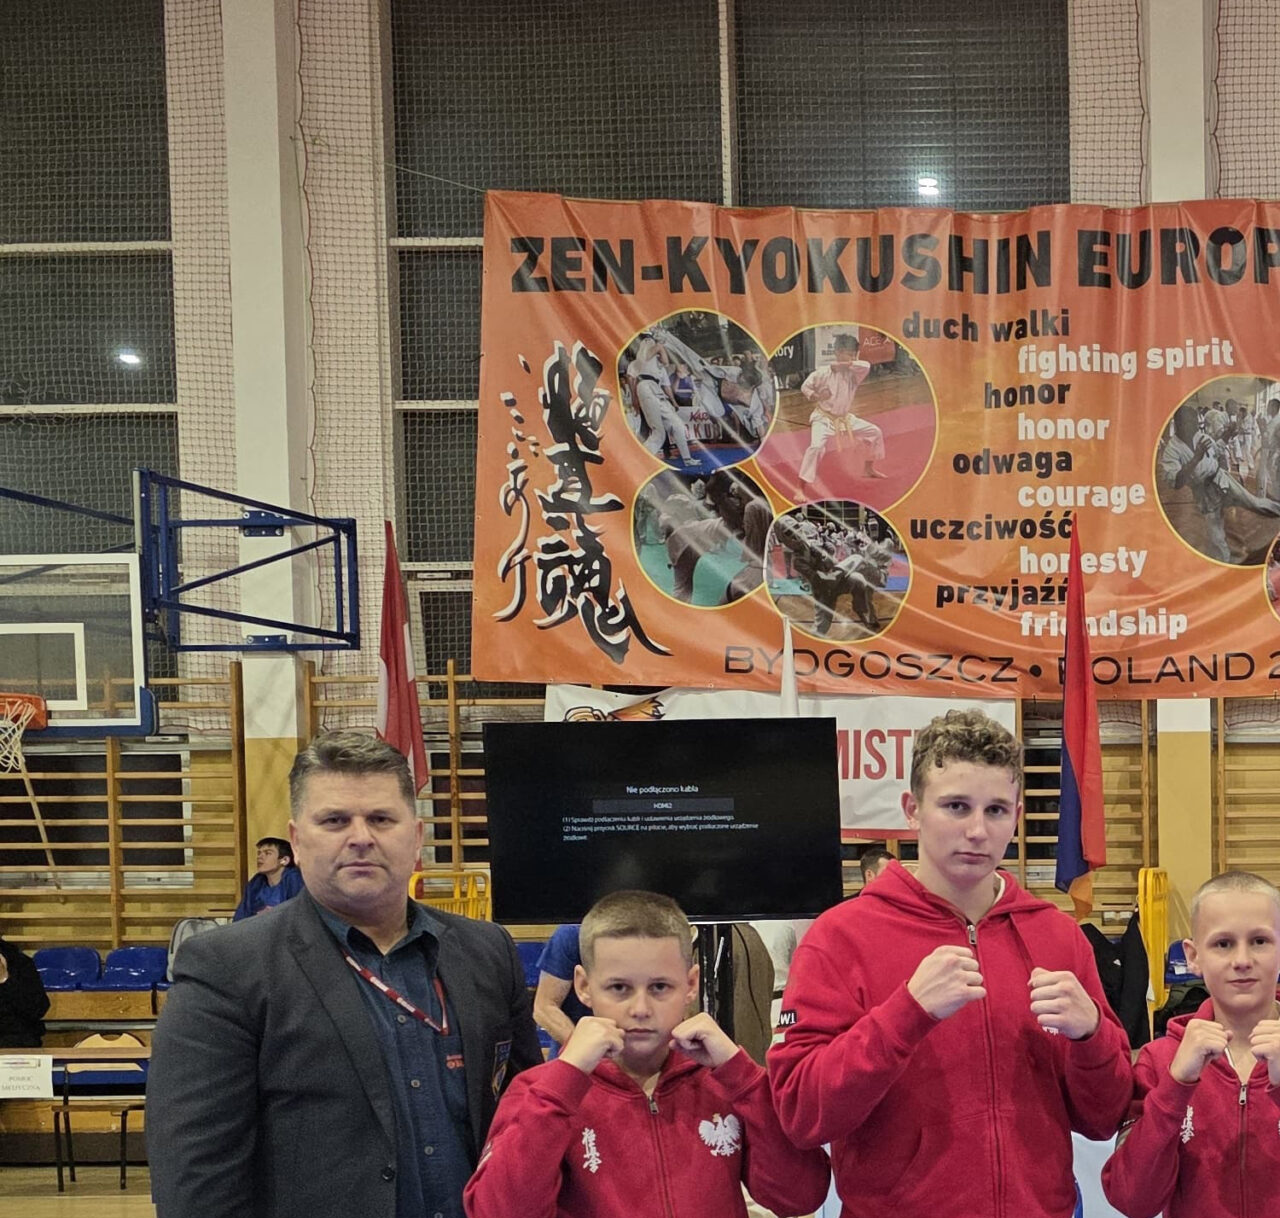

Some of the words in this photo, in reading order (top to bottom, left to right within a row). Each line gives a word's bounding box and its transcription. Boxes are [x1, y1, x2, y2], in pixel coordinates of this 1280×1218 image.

[509, 231, 1052, 296] ZEN-KYOKUSHIN
[902, 311, 979, 342] duch
[989, 308, 1070, 343] walki
[1017, 340, 1137, 381] fighting
[1146, 337, 1234, 378] spirit
[984, 381, 1071, 410] honor
[1018, 412, 1110, 441] honor
[953, 447, 1073, 480] odwaga
[1018, 482, 1146, 514] courage
[910, 510, 1074, 540] uczciwość
[724, 645, 1018, 684] BYDGOSZCZ
[1059, 652, 1256, 686] OLAND
[626, 786, 638, 794] Nie
